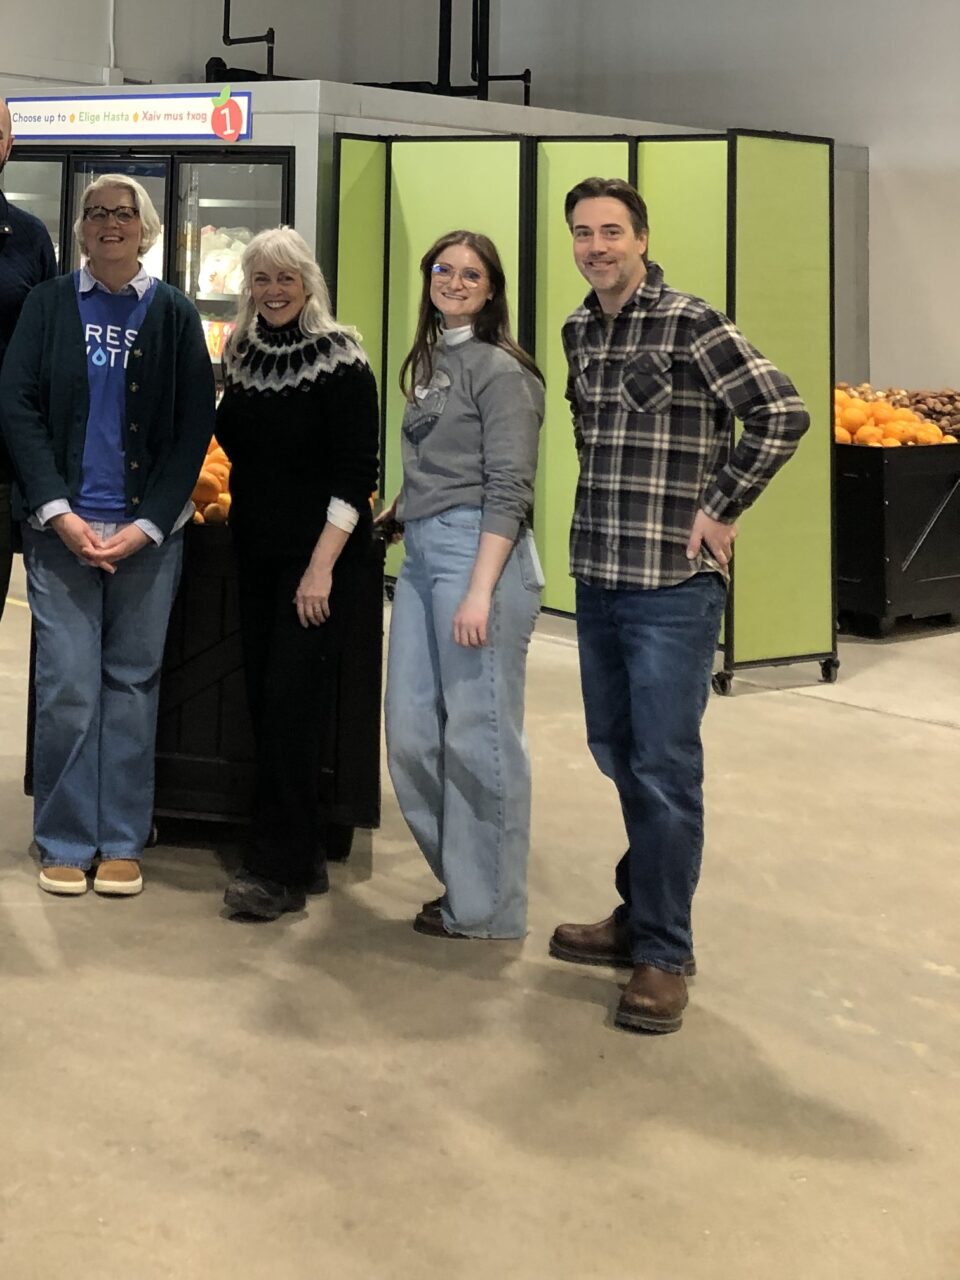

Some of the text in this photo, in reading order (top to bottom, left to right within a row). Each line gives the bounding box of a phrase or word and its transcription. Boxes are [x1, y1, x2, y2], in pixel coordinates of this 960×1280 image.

[12, 112, 41, 123] Choose
[44, 115, 55, 125] up
[57, 113, 66, 123] to
[78, 111, 100, 125] Elige
[103, 111, 129, 122] Hasta
[142, 110, 161, 122] Xaiv
[163, 113, 183, 121] mus
[186, 111, 207, 123] txog
[85, 323, 138, 347] RES
